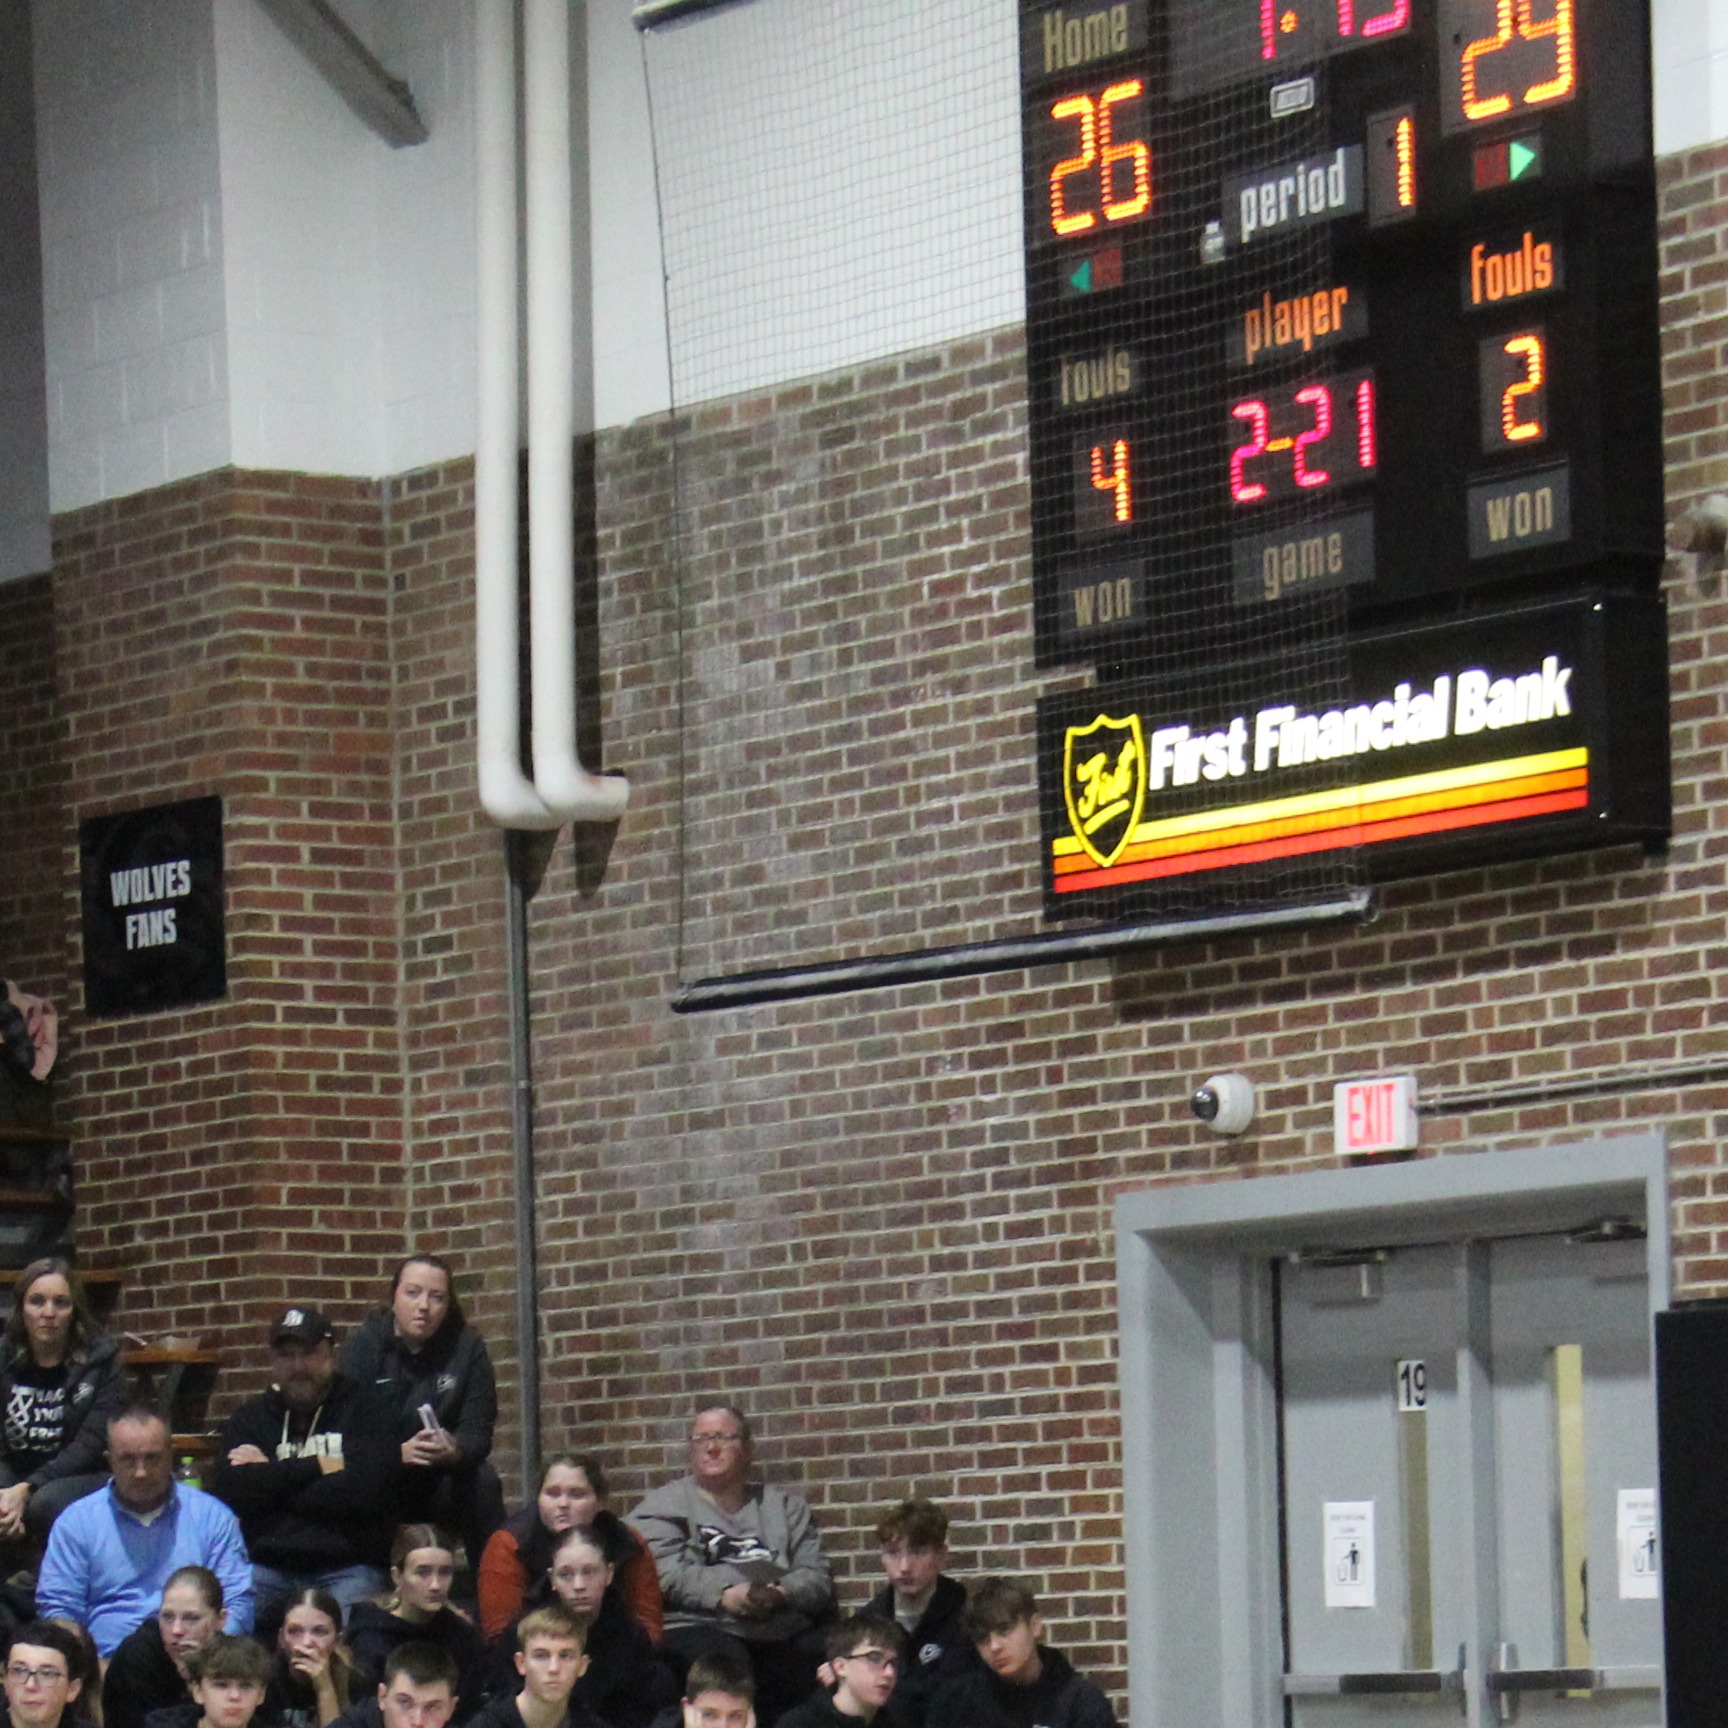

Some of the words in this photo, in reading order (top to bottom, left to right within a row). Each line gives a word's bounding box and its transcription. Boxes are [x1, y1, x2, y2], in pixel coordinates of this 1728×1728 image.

[1042, 4, 1129, 74] Home
[1461, 0, 1575, 121] 29
[1050, 78, 1151, 237] 26
[1239, 147, 1347, 244] period
[1395, 116, 1416, 208] 1
[1470, 231, 1554, 305] fouls
[1244, 285, 1349, 364] player
[1501, 335, 1543, 442] 2
[1090, 439, 1133, 524] 4
[1484, 484, 1554, 542] won
[1262, 530, 1344, 600] game
[1075, 576, 1133, 628] won
[1149, 724, 1247, 791] First
[1253, 675, 1450, 773] Financial
[1454, 655, 1573, 736] Bank
[109, 859, 192, 908] WOLVES
[125, 907, 178, 951] FANS
[1347, 1084, 1397, 1148] EXIT
[1399, 1362, 1428, 1408] 19
